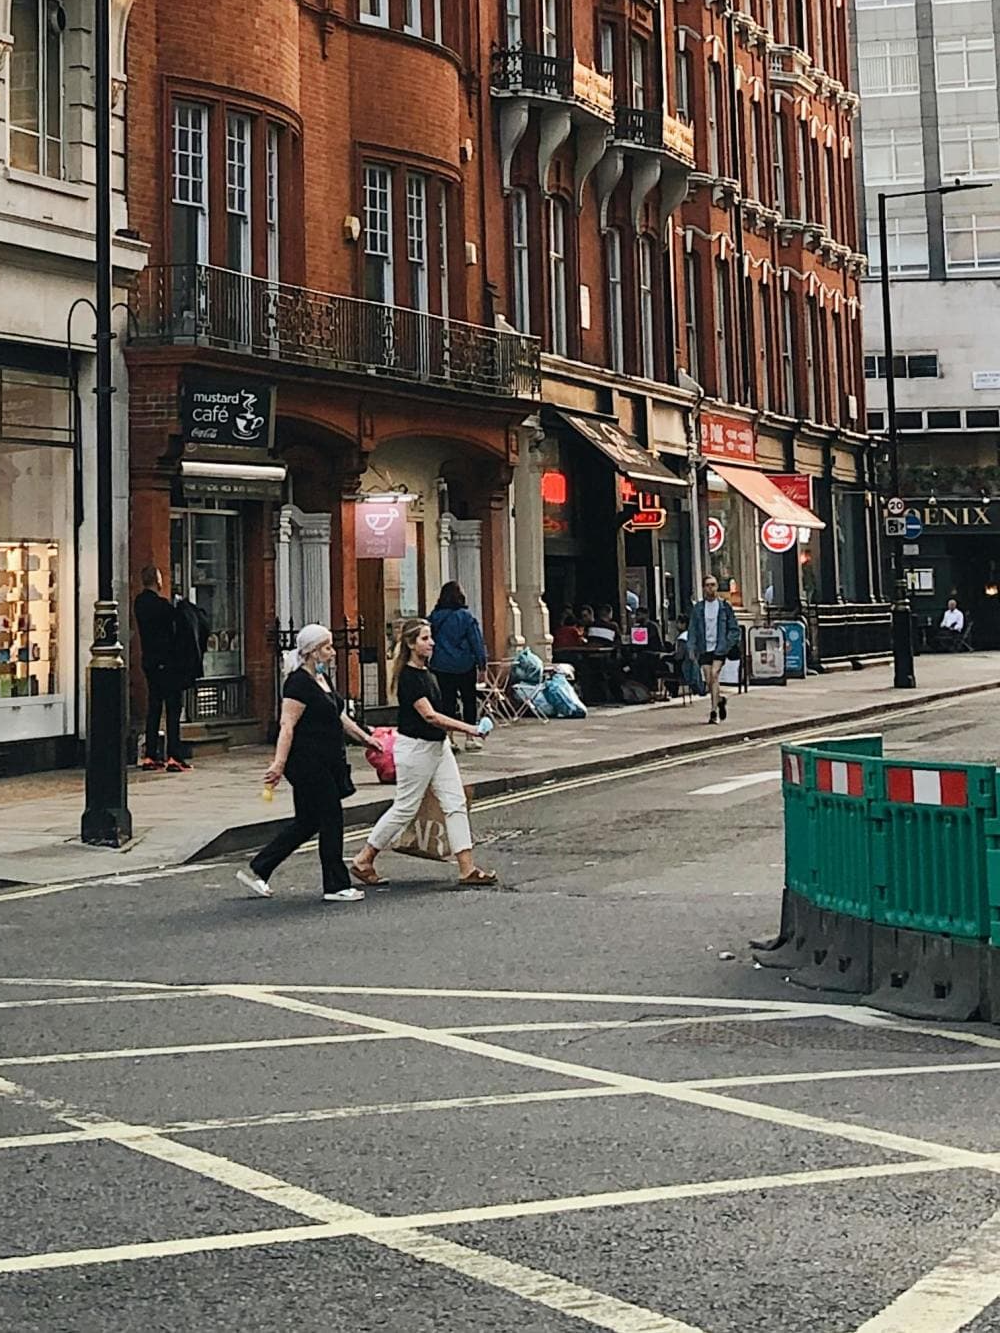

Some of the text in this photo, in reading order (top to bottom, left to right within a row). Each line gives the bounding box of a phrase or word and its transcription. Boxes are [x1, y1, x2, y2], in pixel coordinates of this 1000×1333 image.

[193, 393, 240, 404] mustard
[192, 405, 230, 423] café
[889, 501, 904, 513] 20
